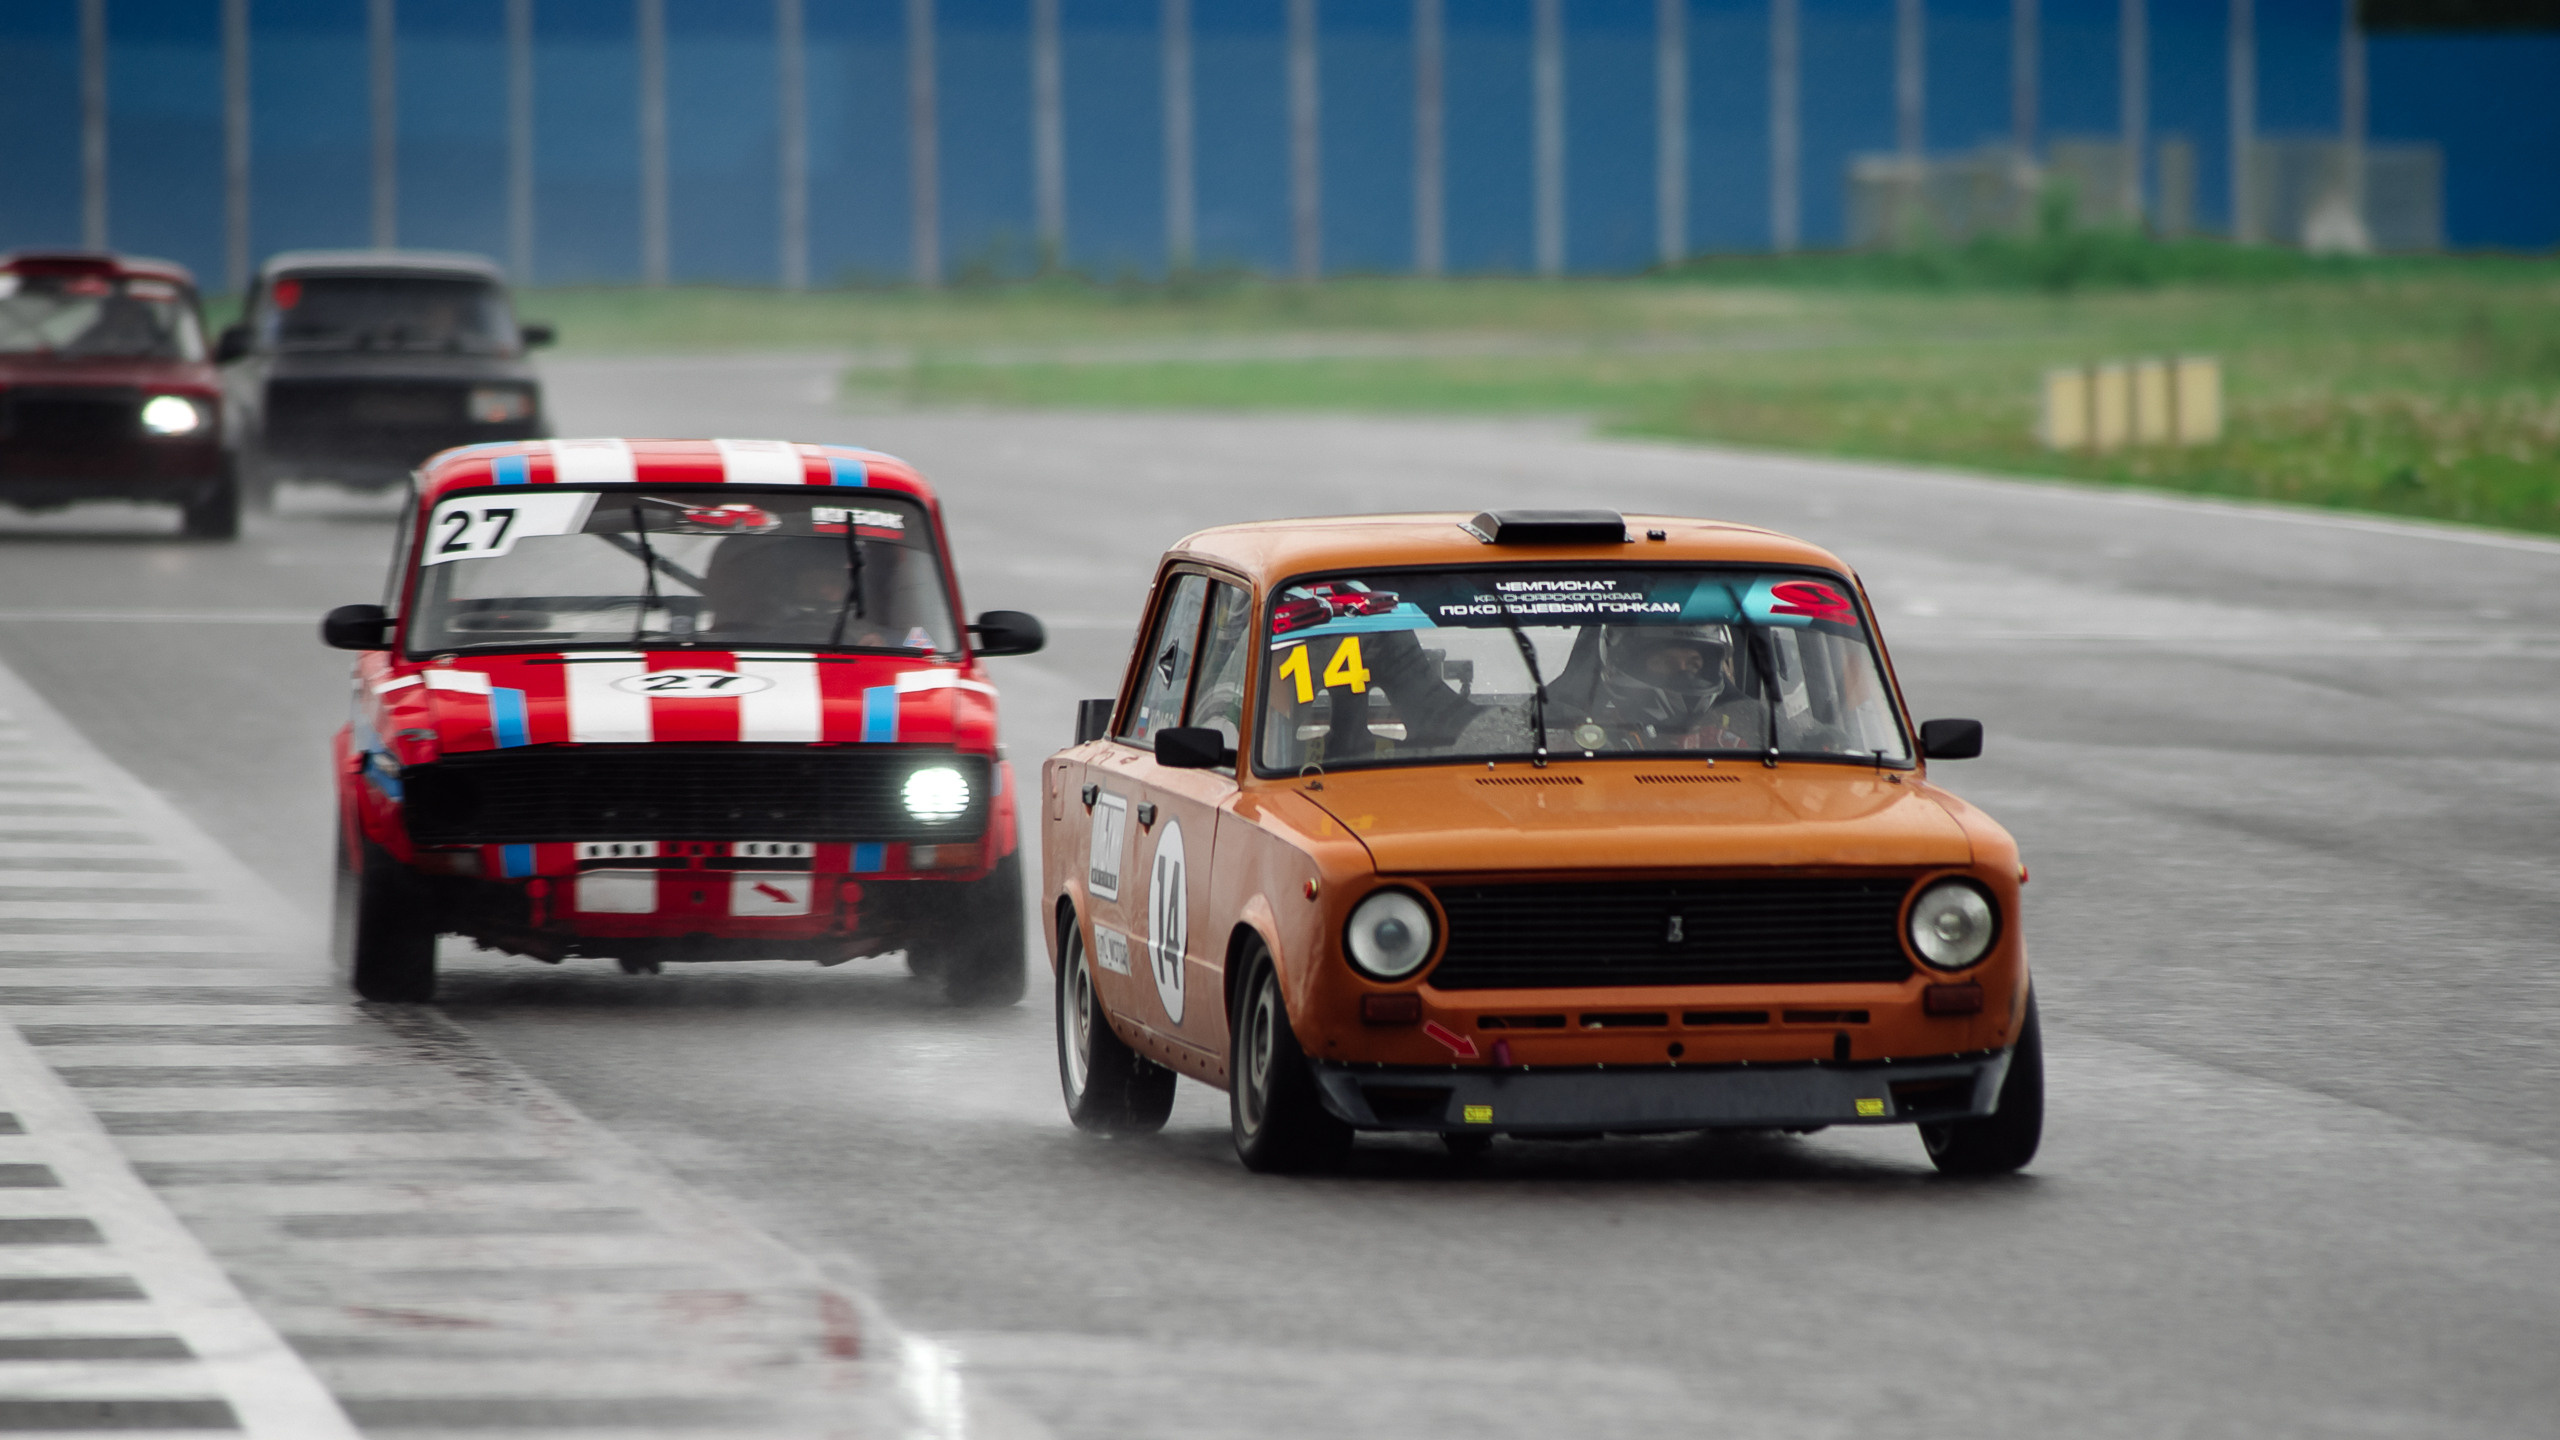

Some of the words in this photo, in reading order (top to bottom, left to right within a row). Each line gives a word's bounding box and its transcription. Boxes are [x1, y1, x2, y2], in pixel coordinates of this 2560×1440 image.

[437, 508, 519, 554] 27
[1495, 581, 1617, 592] ЧЕМПИОНАТ
[1439, 604, 1468, 616] ПО
[1598, 602, 1681, 613] ГОНКАМ
[640, 674, 744, 691] 27
[1278, 636, 1371, 704] 14
[1157, 854, 1181, 991] 14
